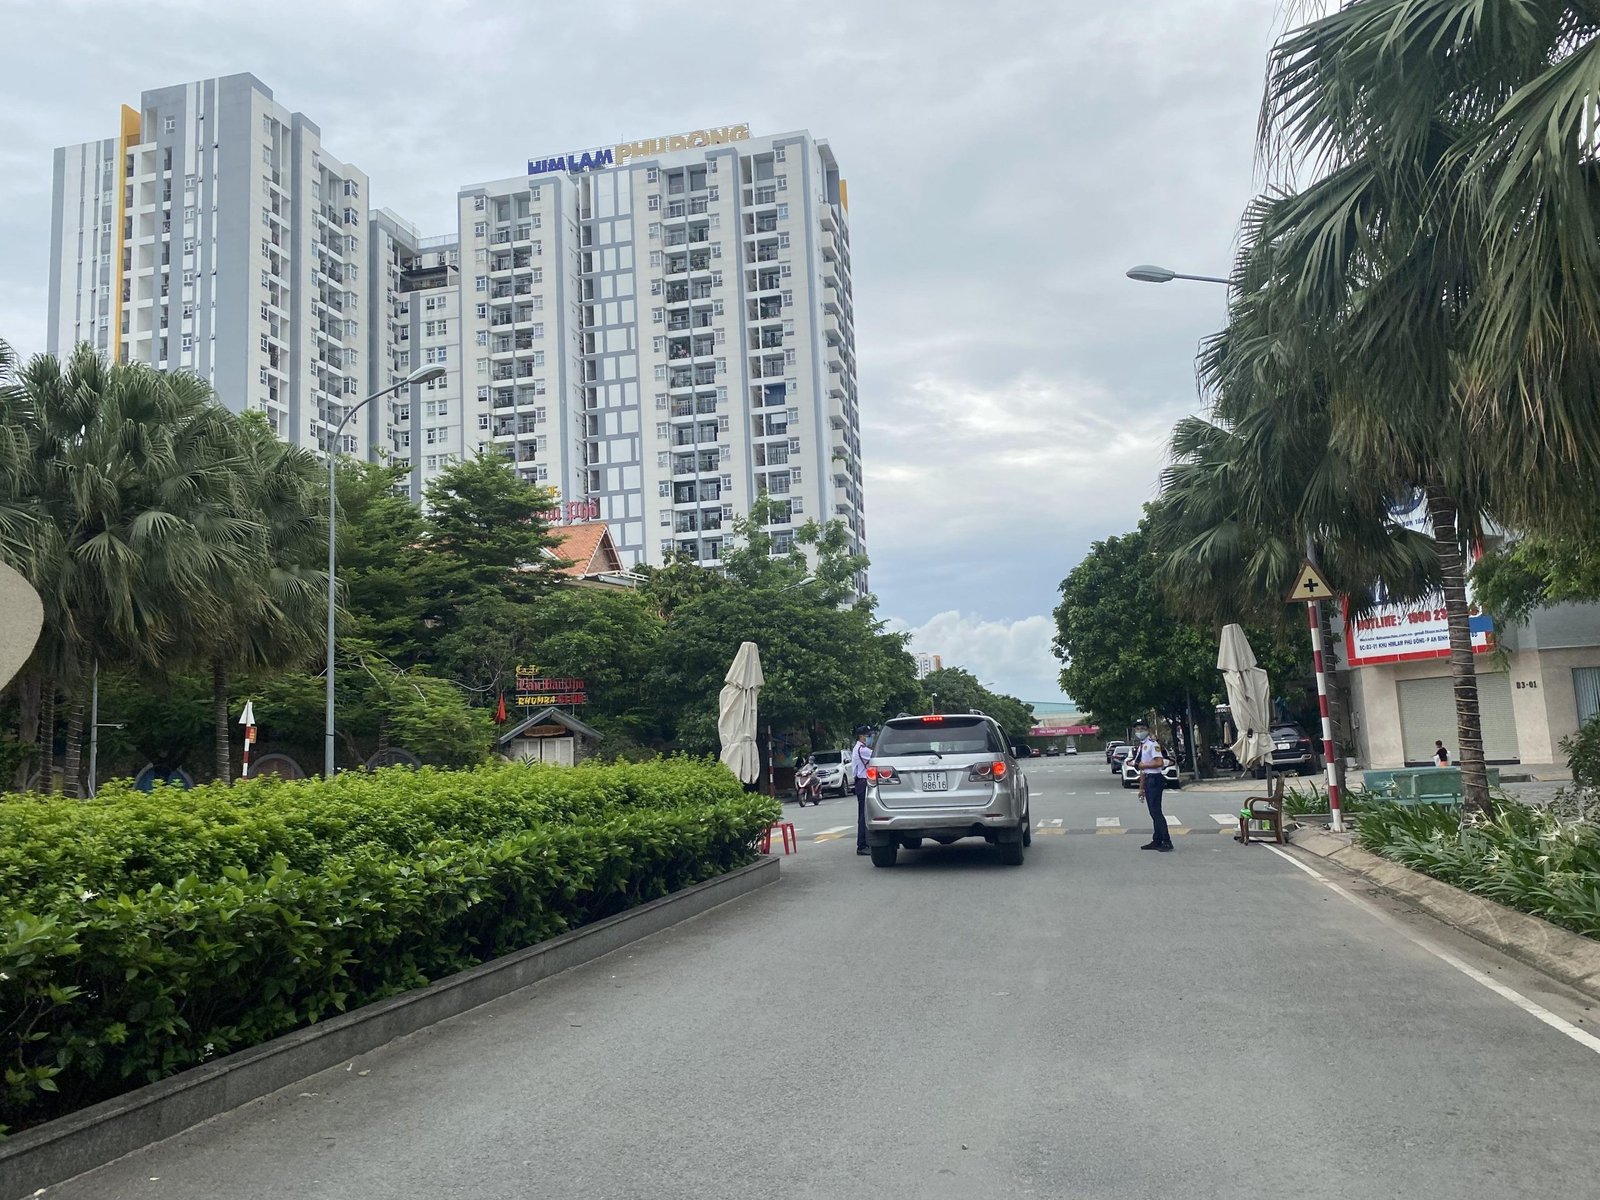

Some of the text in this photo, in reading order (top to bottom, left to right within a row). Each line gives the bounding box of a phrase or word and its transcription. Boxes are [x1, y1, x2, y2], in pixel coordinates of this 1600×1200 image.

[567, 149, 614, 172] LAM
[1515, 680, 1538, 689] B3-01
[927, 773, 940, 781] 51F
